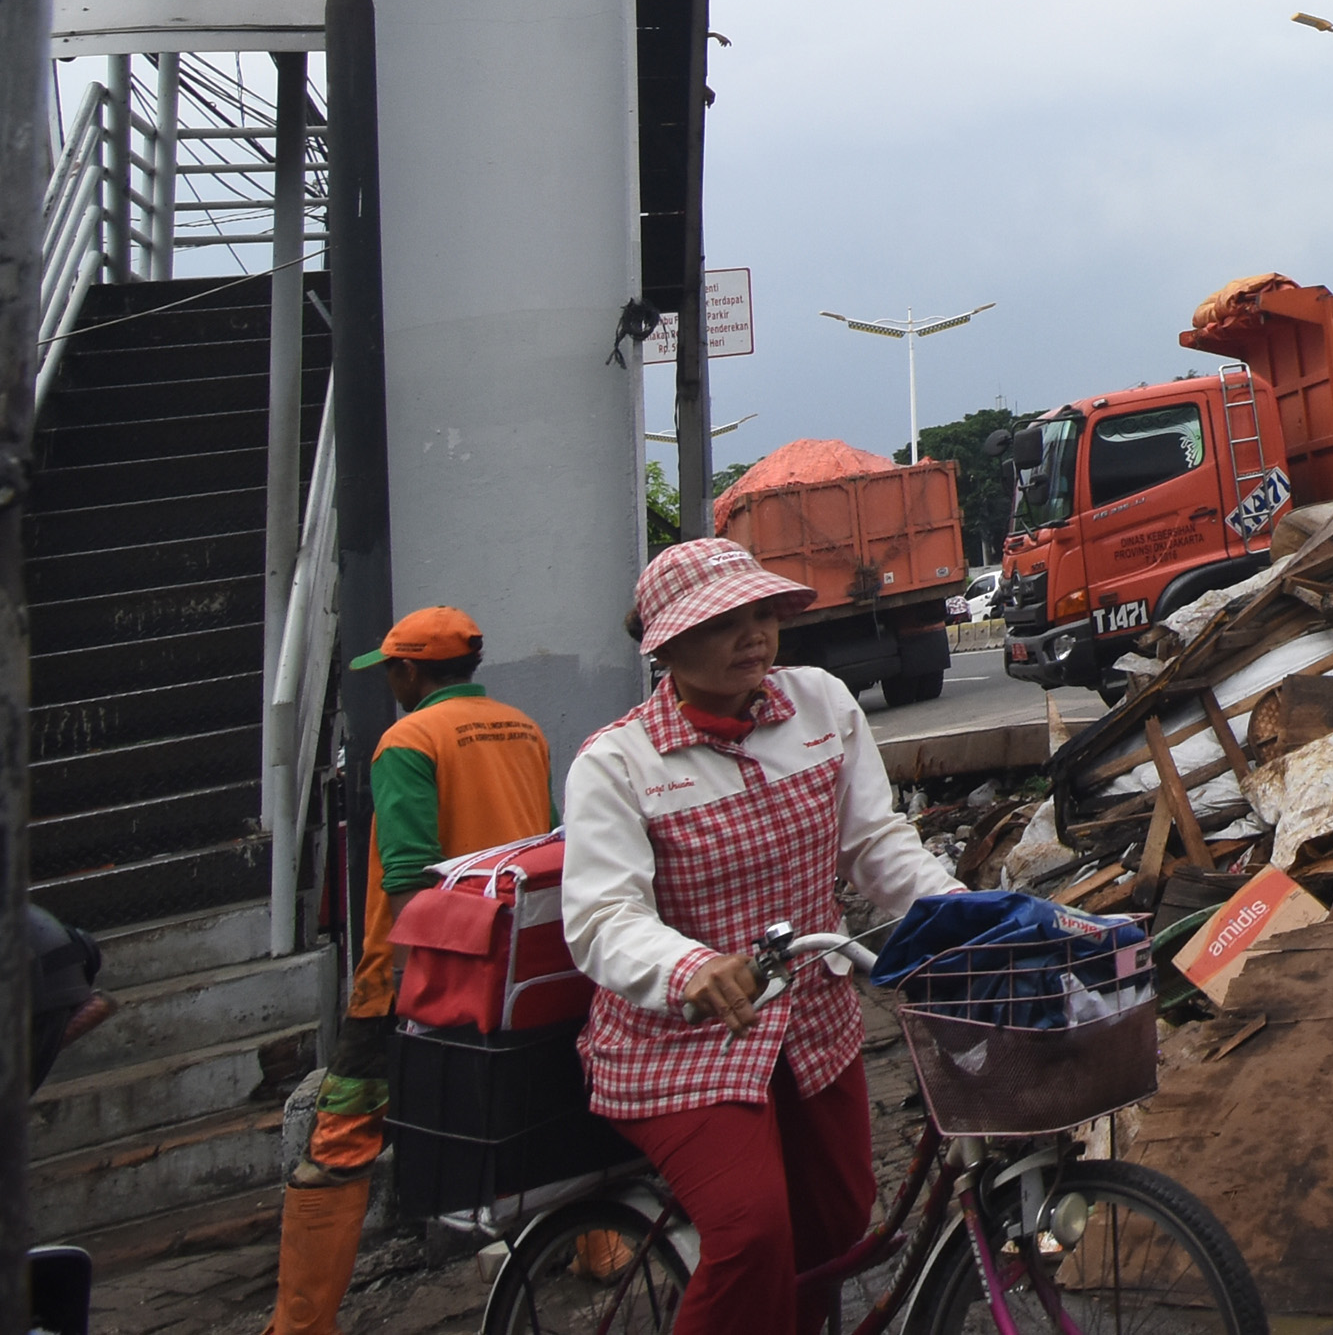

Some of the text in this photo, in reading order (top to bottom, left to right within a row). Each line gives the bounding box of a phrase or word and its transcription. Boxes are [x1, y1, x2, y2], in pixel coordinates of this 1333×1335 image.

[710, 295, 744, 308] Terdapat
[707, 310, 730, 321] Parkir
[1121, 523, 1197, 547] DINAS KEBERSIHAN
[1114, 545, 1153, 562] PROVINSI
[1168, 533, 1205, 549] JAKARTA
[1207, 899, 1269, 958] amidis
